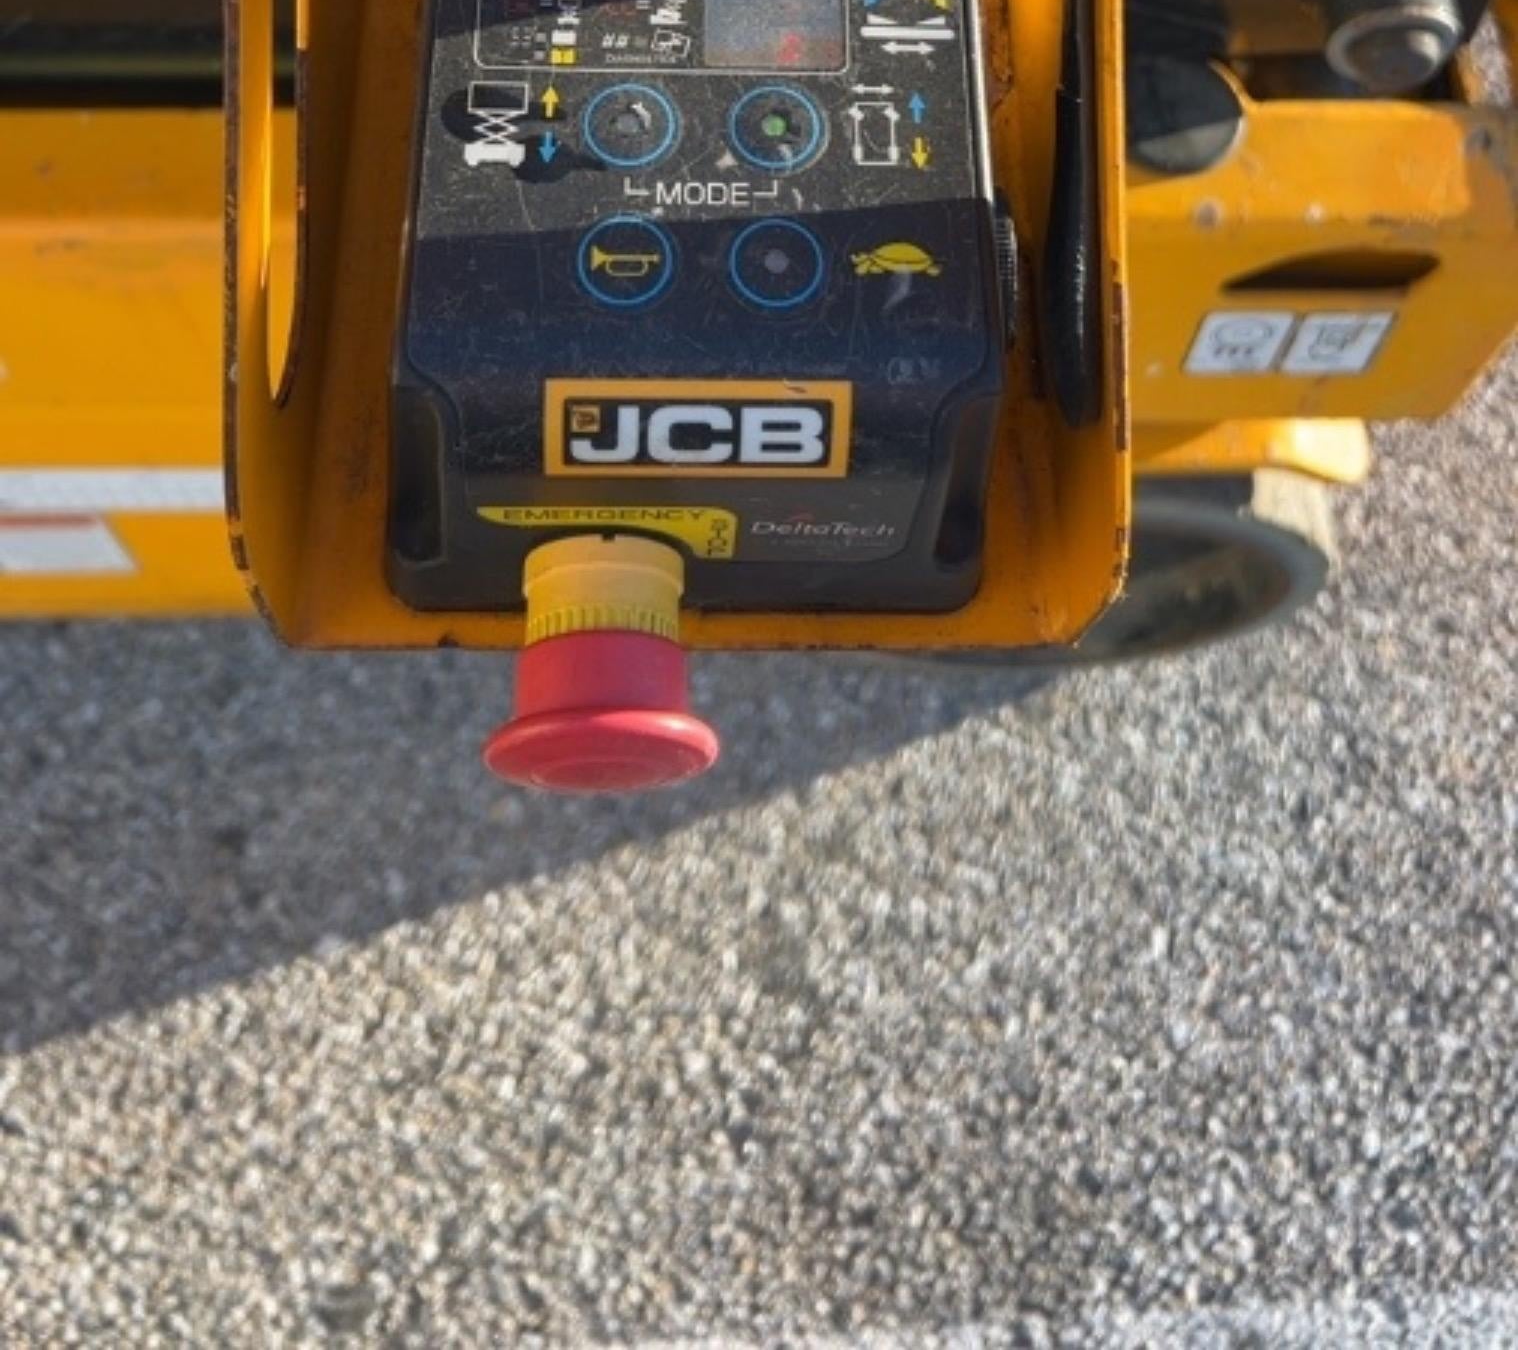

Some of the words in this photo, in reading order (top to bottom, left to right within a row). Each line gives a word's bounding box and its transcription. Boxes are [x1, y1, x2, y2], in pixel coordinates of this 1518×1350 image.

[655, 181, 750, 205] MODE
[569, 404, 825, 463] JCB
[502, 509, 705, 520] EMERGENCY
[751, 521, 895, 536] DeltaTech
